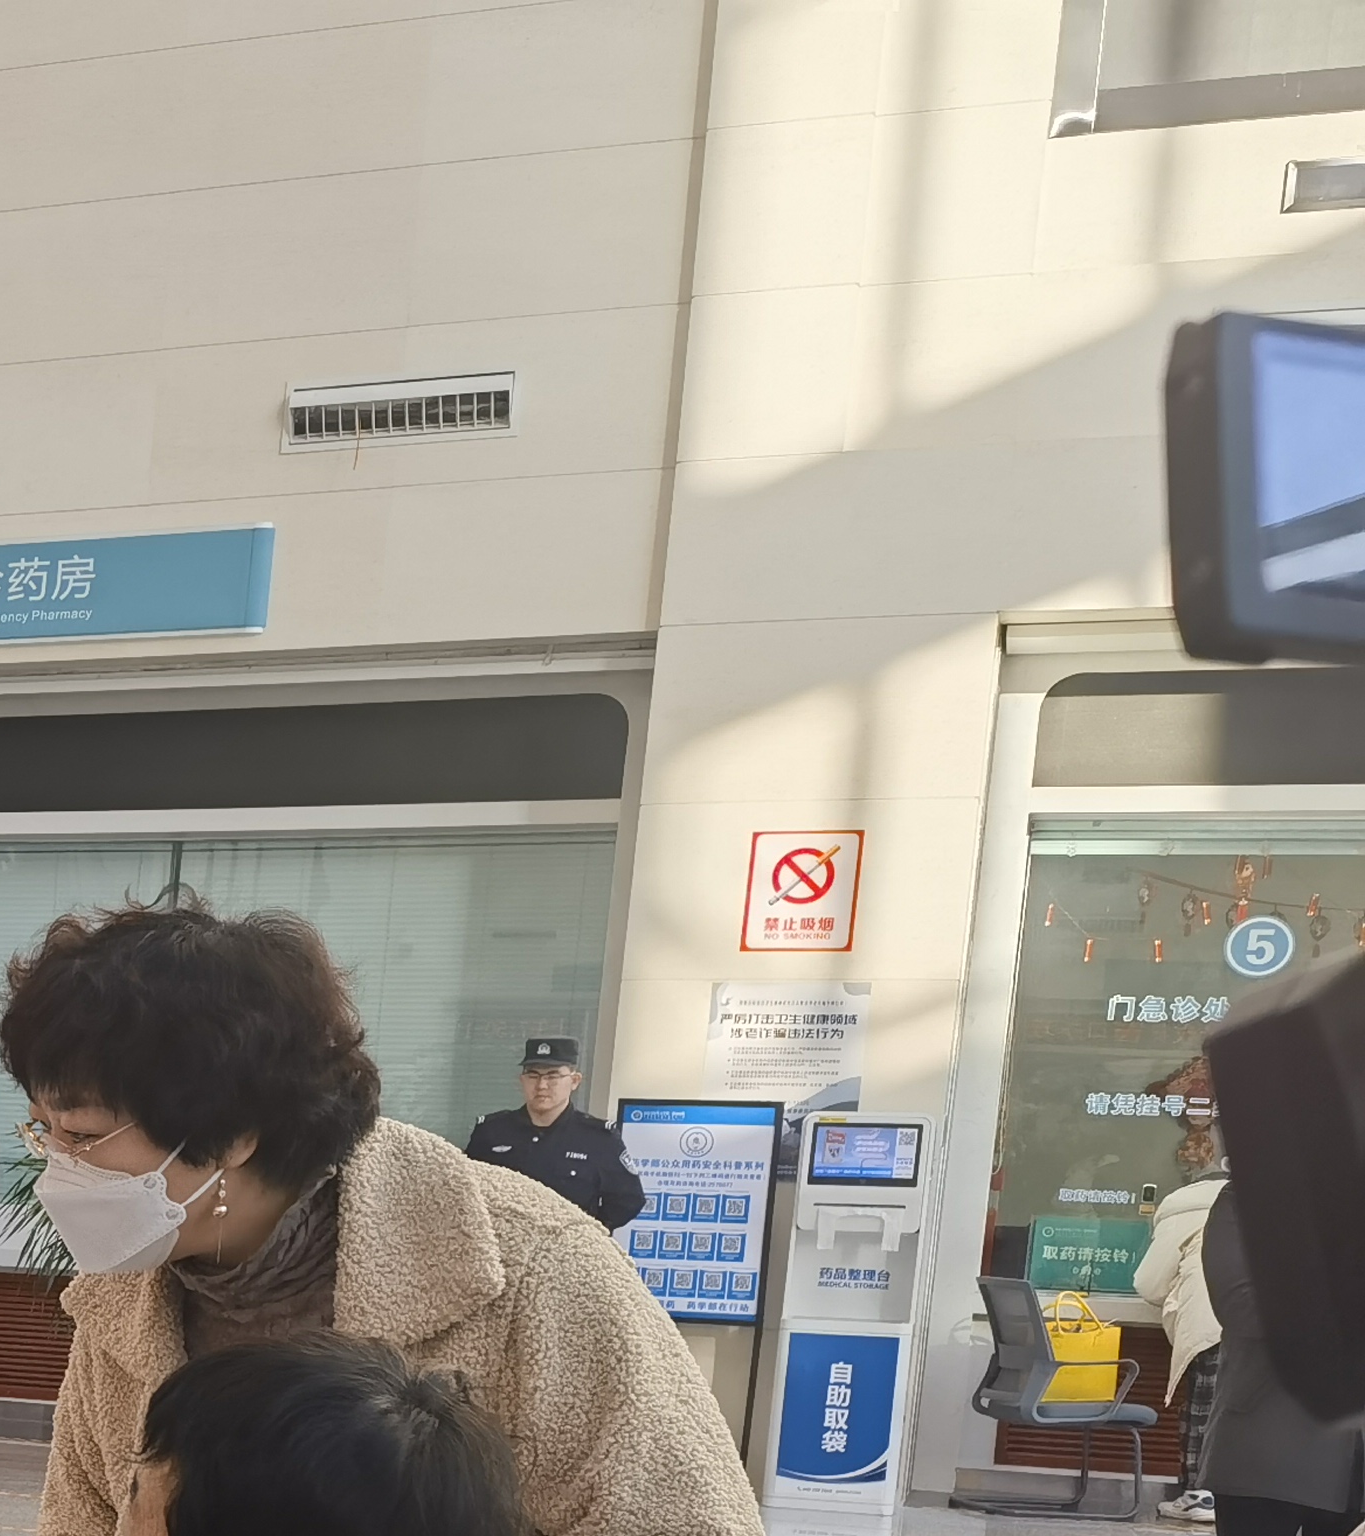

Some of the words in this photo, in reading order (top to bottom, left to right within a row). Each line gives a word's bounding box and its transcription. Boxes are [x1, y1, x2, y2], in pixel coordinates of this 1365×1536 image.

[32, 609, 93, 621] Pharmacy
[764, 917, 835, 932] 禁止吸烟
[764, 932, 779, 940] NO
[783, 932, 831, 941] SMOKING
[1245, 928, 1276, 965] 5
[719, 1012, 858, 1026] 严厉打击卫生健康领域
[729, 1027, 845, 1040] 涉老诈骗违法行为
[819, 1266, 891, 1282] 药品整理台
[817, 1280, 851, 1289] MEDICAL
[854, 1282, 890, 1291] STORAGE
[820, 1361, 853, 1453] 自助取袋
